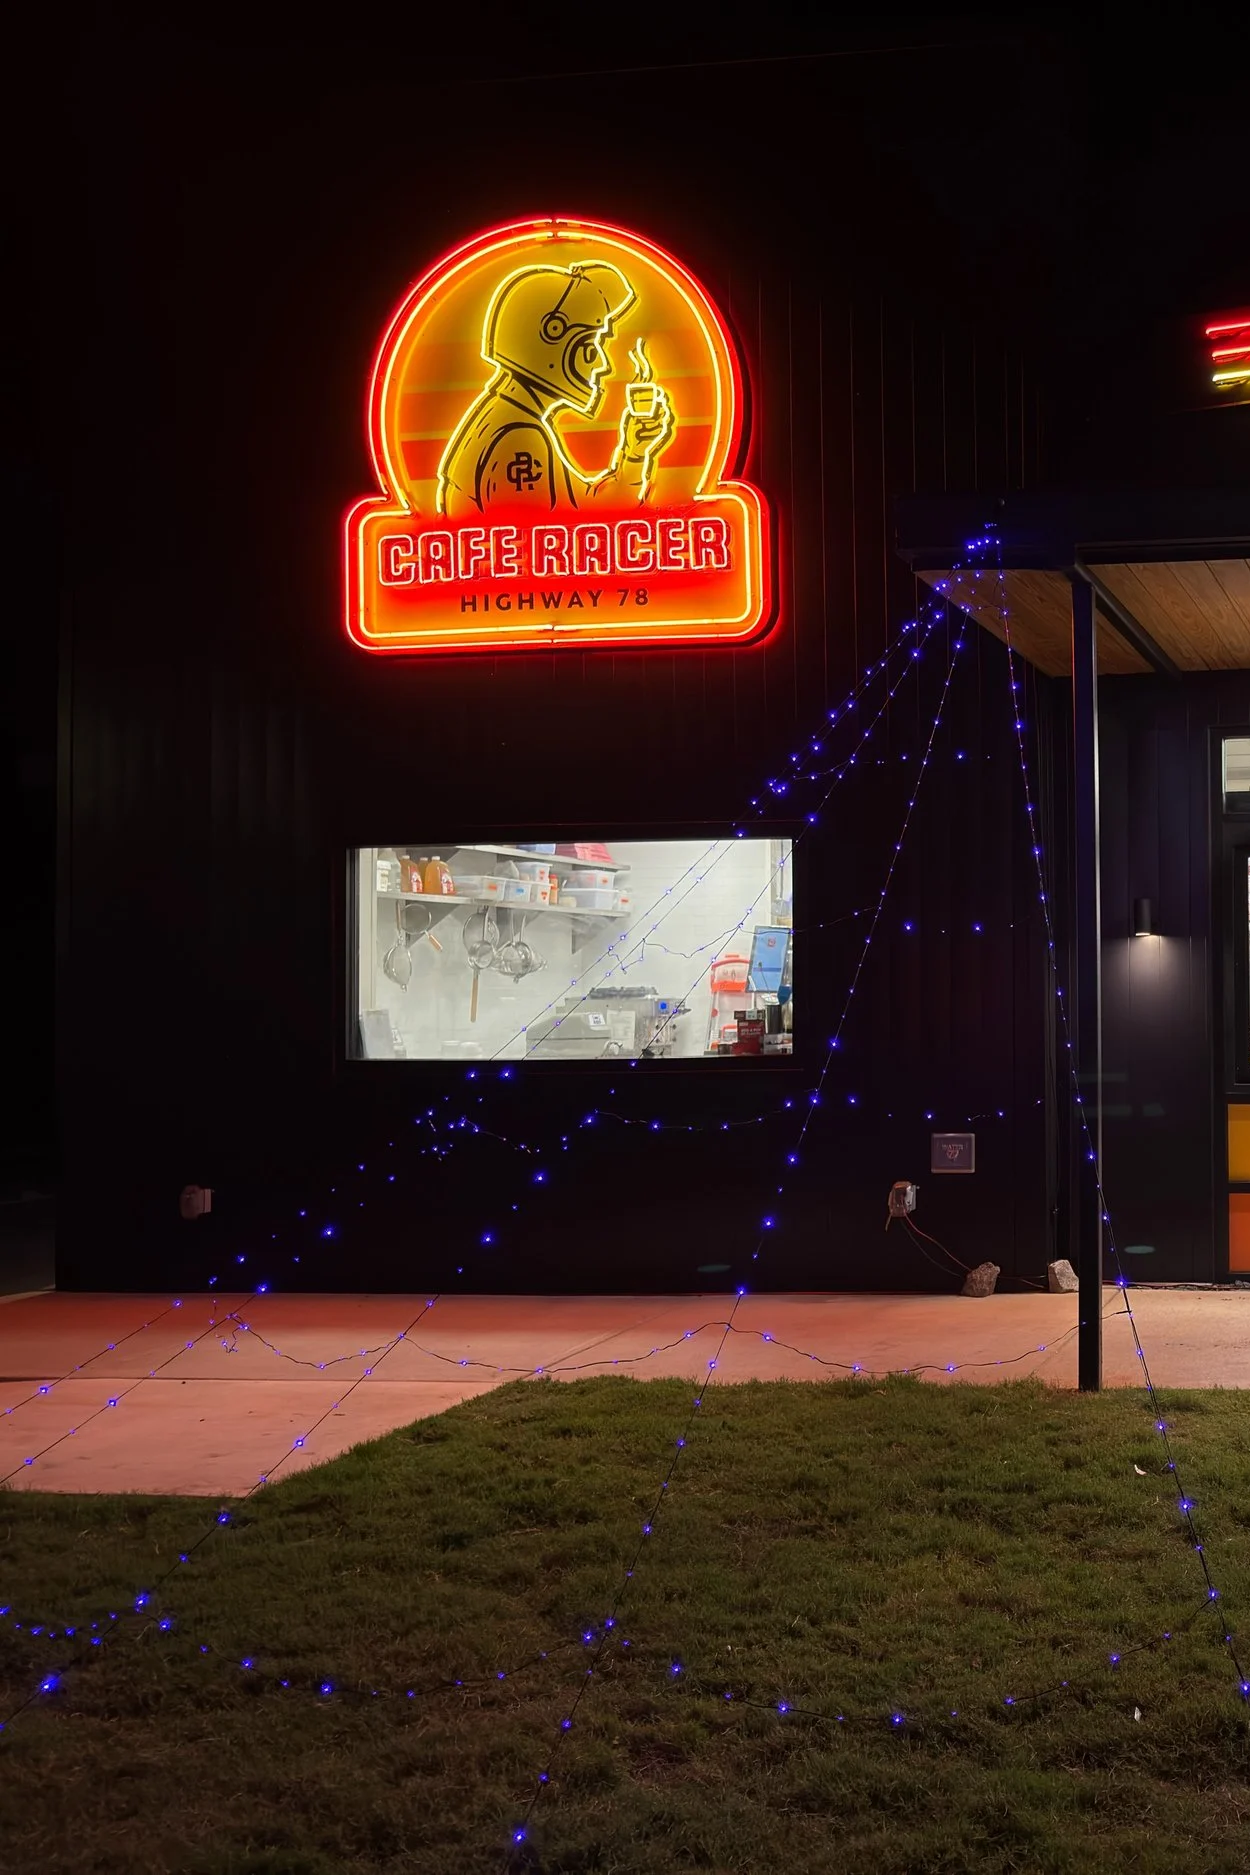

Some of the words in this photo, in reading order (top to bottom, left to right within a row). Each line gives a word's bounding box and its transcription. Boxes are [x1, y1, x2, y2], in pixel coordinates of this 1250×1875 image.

[378, 525, 519, 587] CAFE
[532, 516, 732, 578] RACER
[460, 590, 603, 613] HIGHWAY
[617, 588, 650, 607] 78
